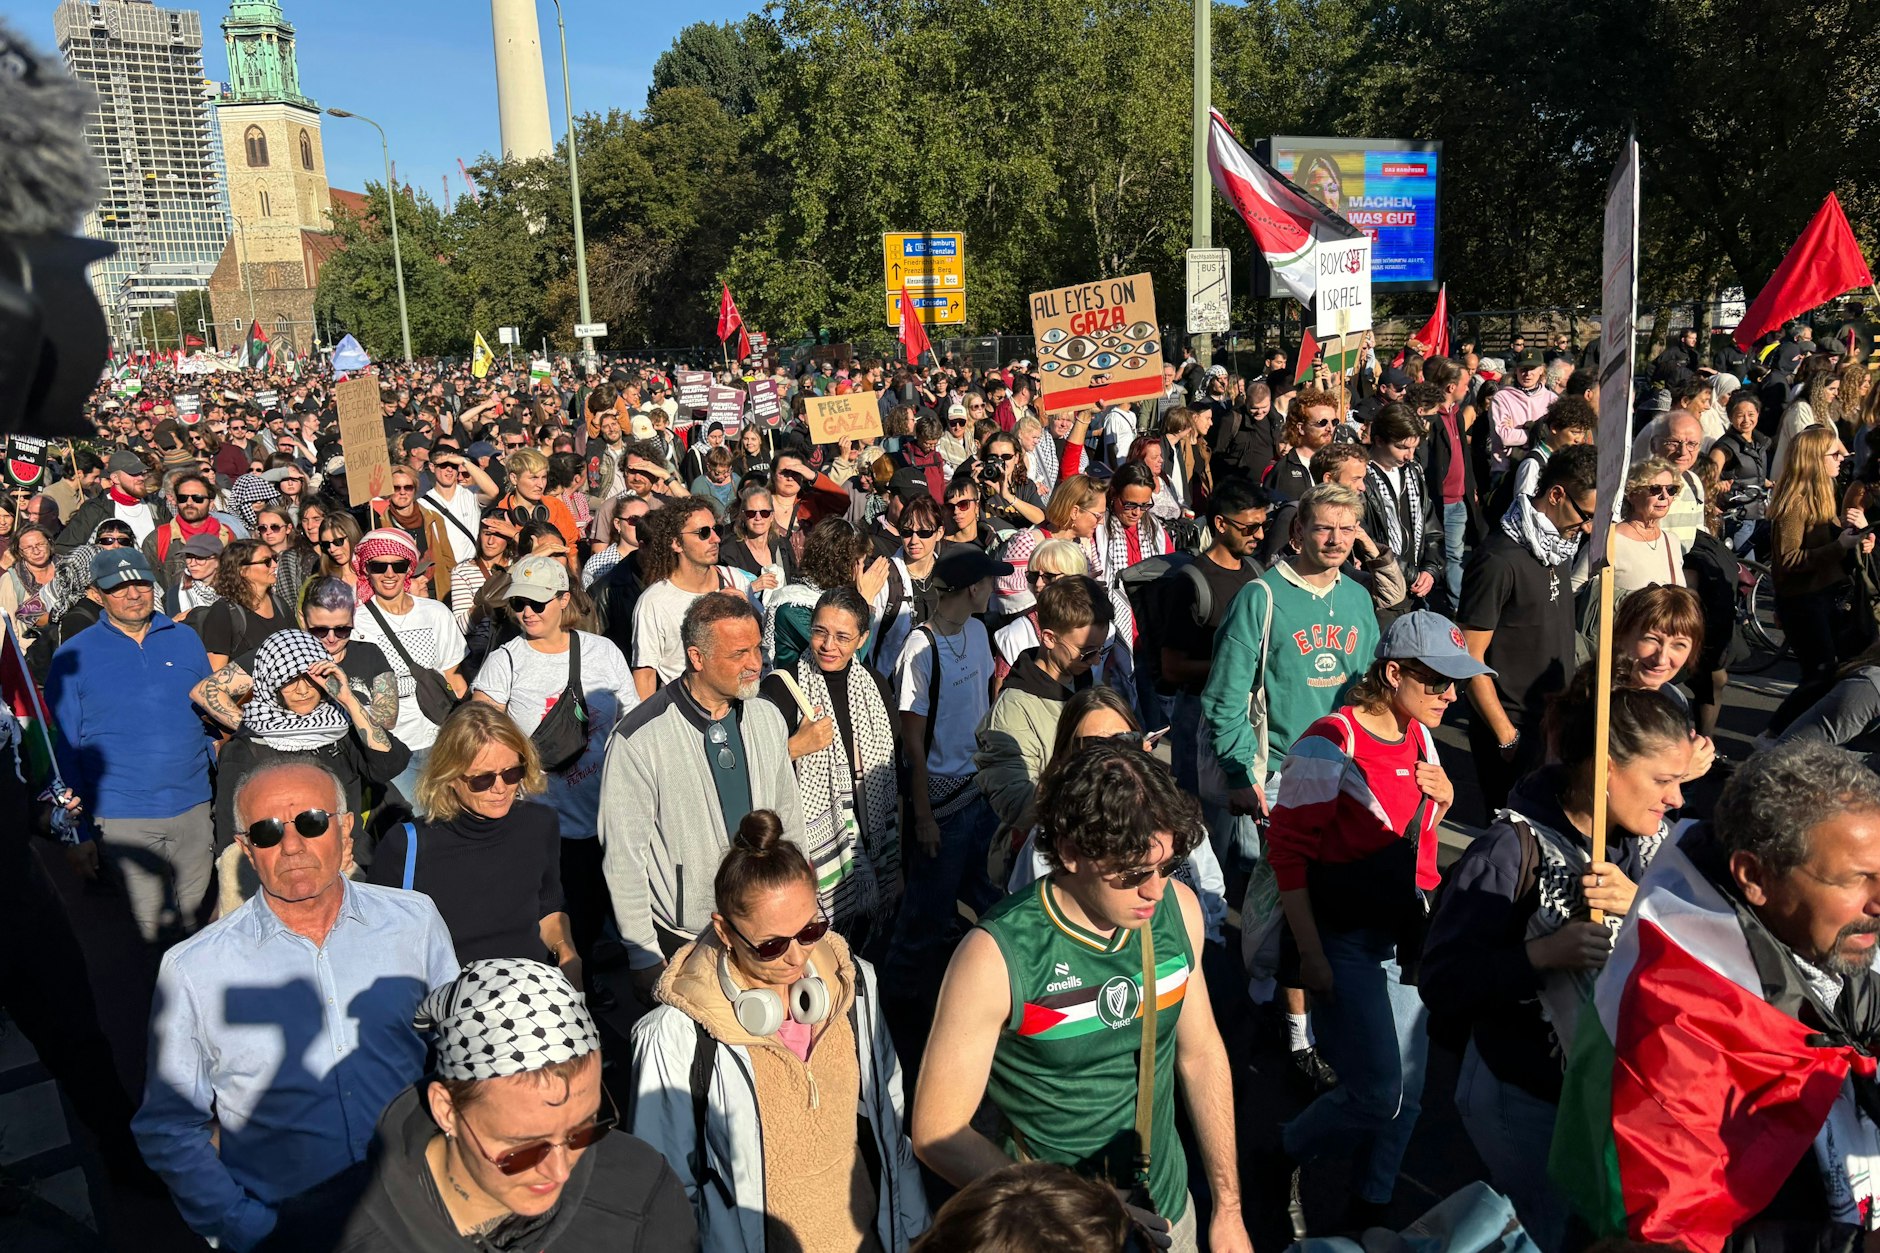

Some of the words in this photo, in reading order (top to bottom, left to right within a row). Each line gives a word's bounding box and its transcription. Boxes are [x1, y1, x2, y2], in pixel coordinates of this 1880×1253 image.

[1348, 196, 1416, 210] MACHEN,
[1347, 212, 1383, 224] WAS
[1386, 212, 1416, 224] GUT
[928, 240, 956, 248] Hamburg
[1201, 263, 1217, 272] BUS
[1034, 293, 1060, 320] ALL
[1065, 285, 1105, 314] EYES
[1110, 280, 1136, 305] ON
[1322, 286, 1362, 311] ISRAEL
[1070, 306, 1126, 336] GAZA
[337, 379, 378, 402] GERMAN
[339, 398, 380, 421] RESEARCH
[817, 399, 851, 417] FREE
[347, 421, 384, 445] SUPPORTS
[823, 410, 879, 435] GAZA
[346, 444, 389, 471] GENOCIDE
